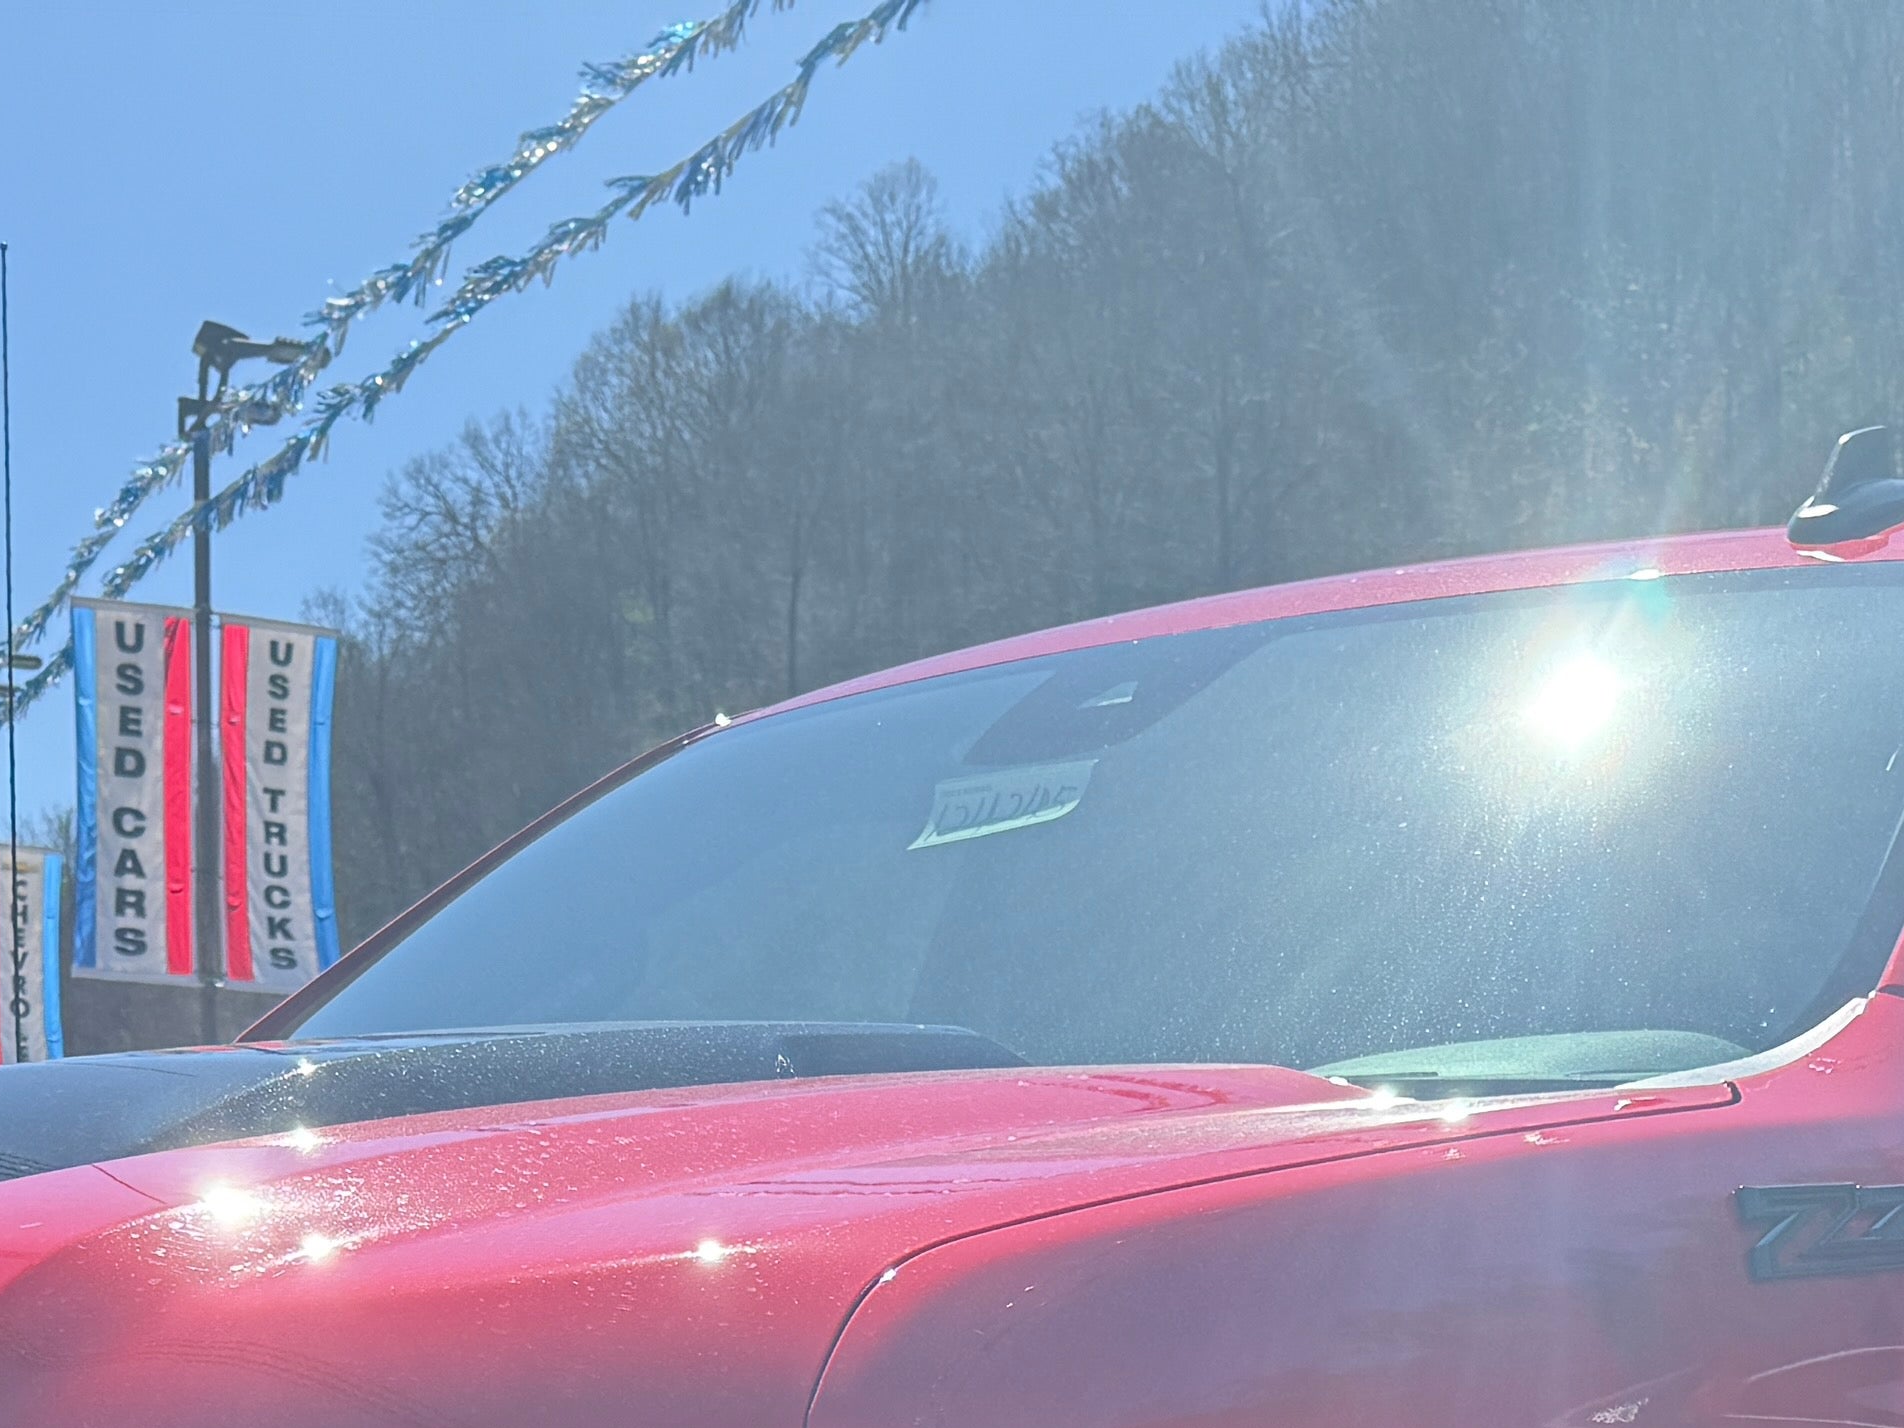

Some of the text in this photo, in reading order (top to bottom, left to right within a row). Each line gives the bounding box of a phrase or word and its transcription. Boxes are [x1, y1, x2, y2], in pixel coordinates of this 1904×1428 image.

[111, 620, 148, 957] USED CARS
[263, 639, 298, 972] USED TRUCKS
